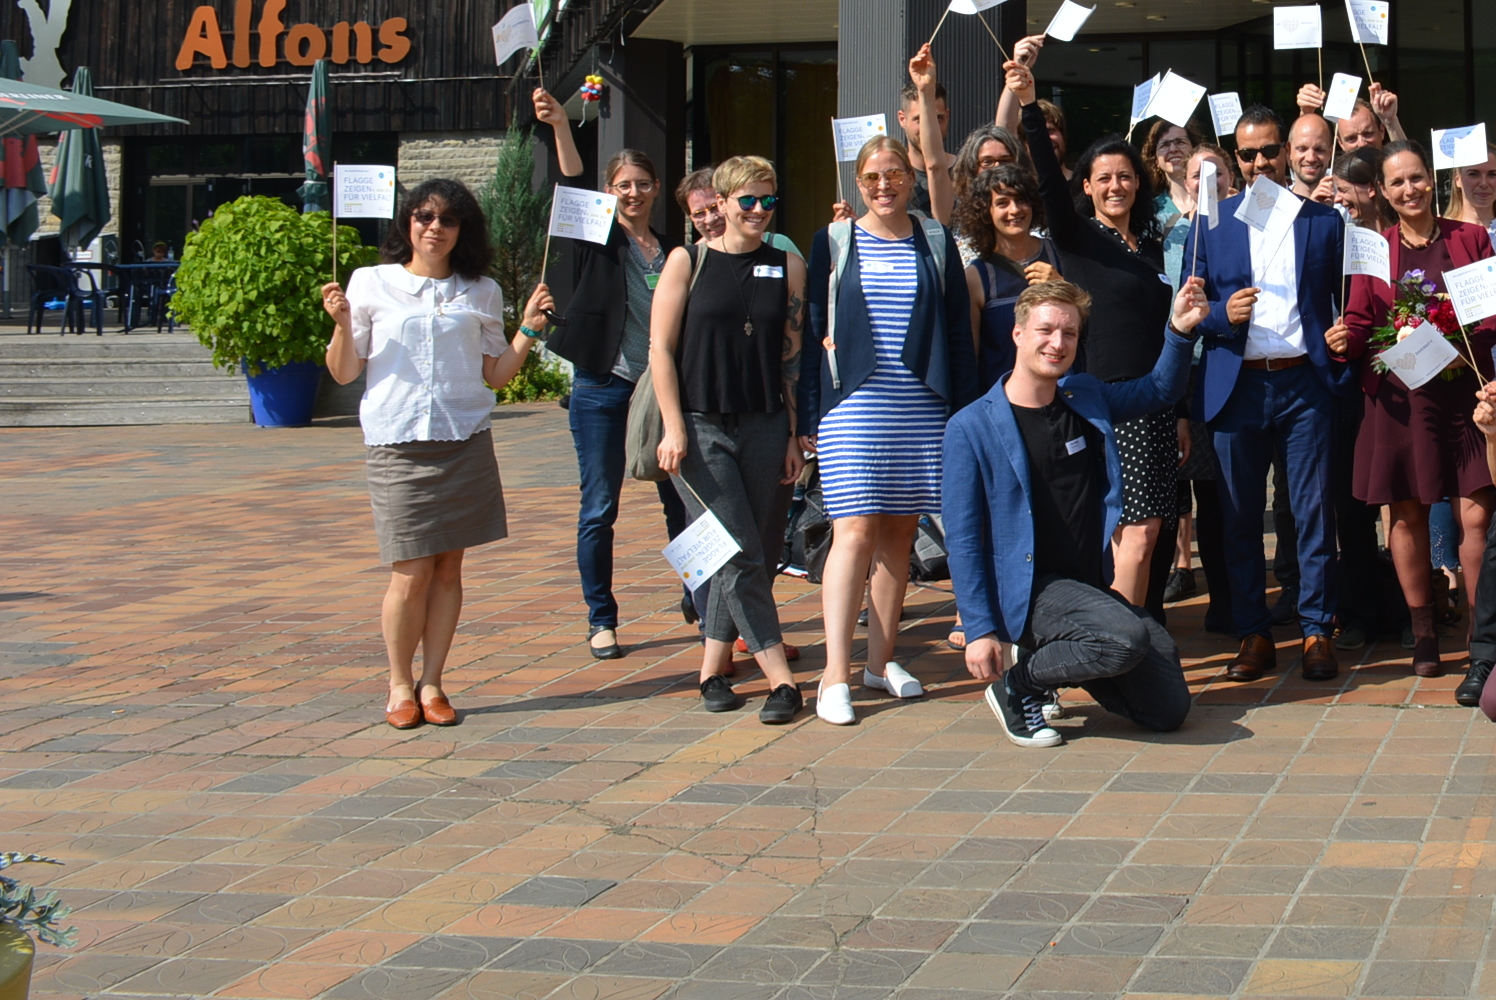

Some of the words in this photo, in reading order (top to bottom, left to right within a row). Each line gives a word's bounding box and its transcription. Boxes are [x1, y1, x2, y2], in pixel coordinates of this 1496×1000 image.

[560, 198, 590, 209] FLAGGE
[559, 206, 588, 216] ZEIGEN
[1454, 274, 1485, 289] FLAGGE
[1458, 283, 1487, 298] ZEIGEN
